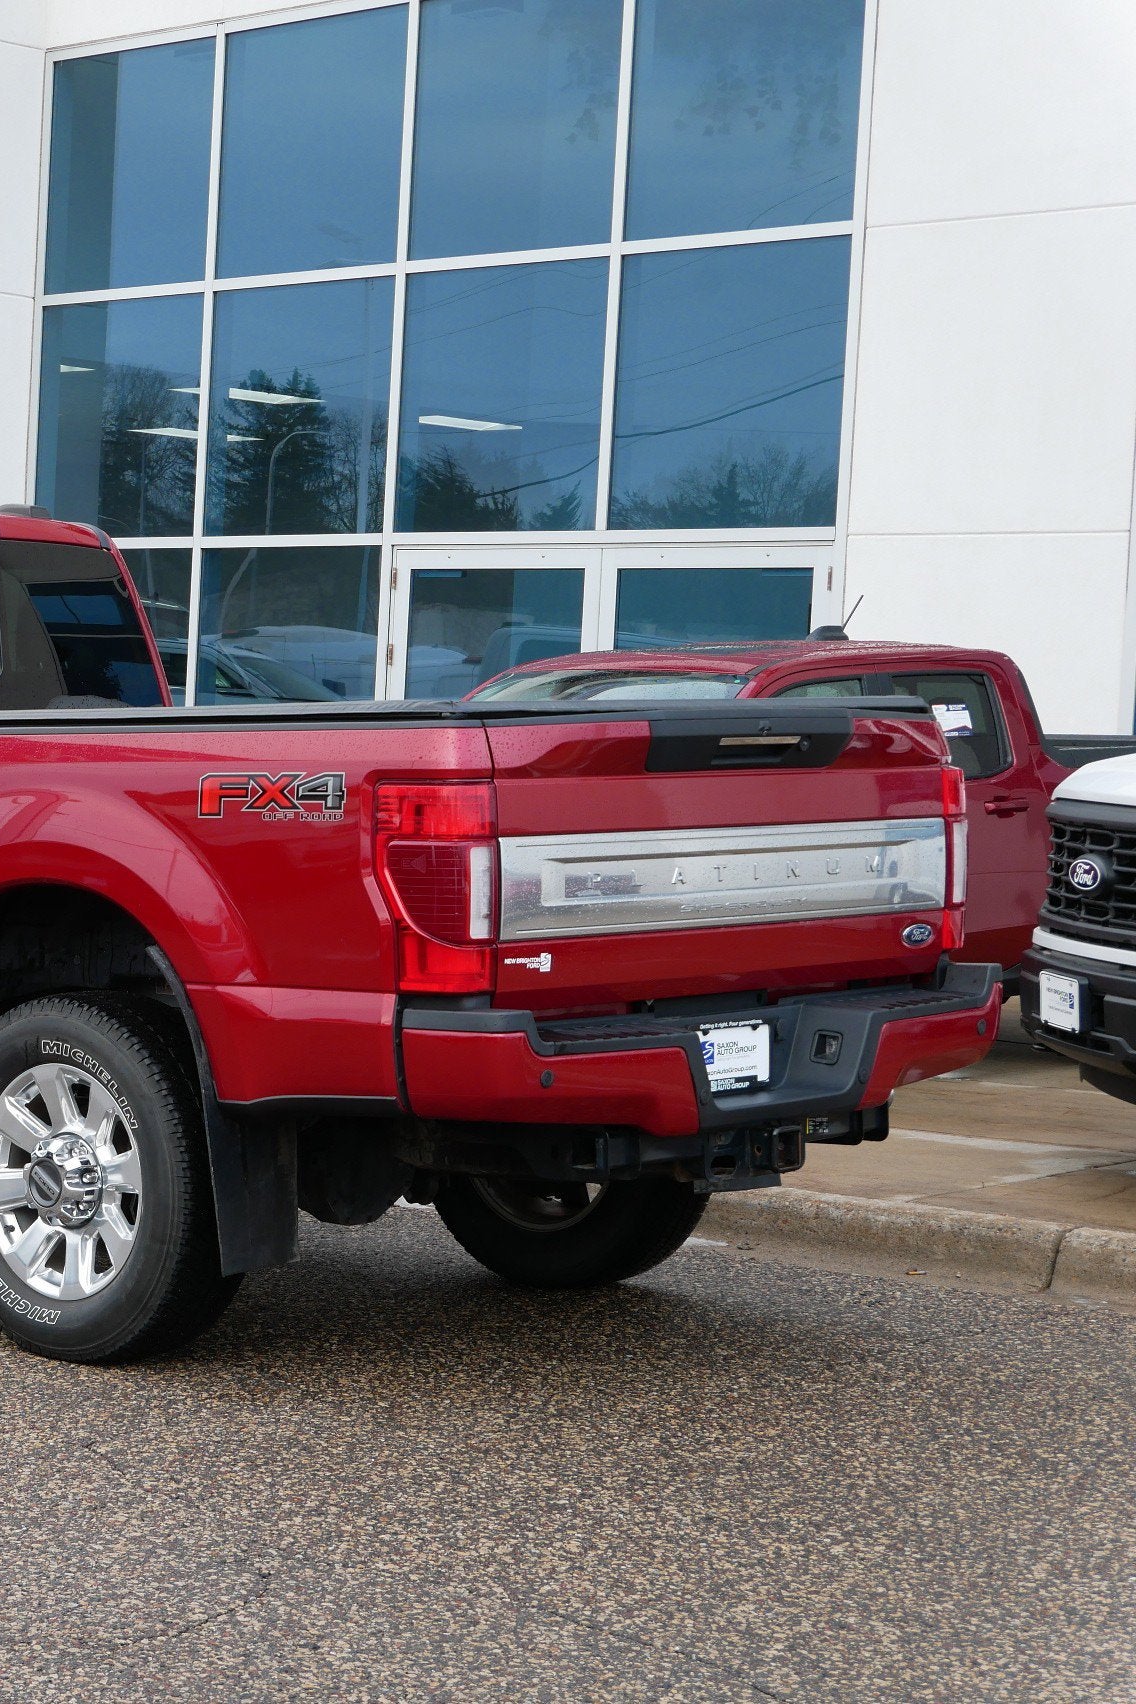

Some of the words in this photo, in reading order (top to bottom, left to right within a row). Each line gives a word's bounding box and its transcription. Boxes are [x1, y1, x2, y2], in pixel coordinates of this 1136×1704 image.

[198, 772, 347, 818] FX4
[262, 811, 294, 822] OFF
[299, 811, 344, 822] ROAD
[588, 855, 881, 890] PLATINUM
[1074, 863, 1094, 886] Ford
[716, 1041, 739, 1049] SAXON
[716, 1048, 734, 1056] AUTO
[735, 1044, 757, 1054] GROUP
[41, 1040, 139, 1129] MICHELIN
[731, 1081, 750, 1089] GROUP
